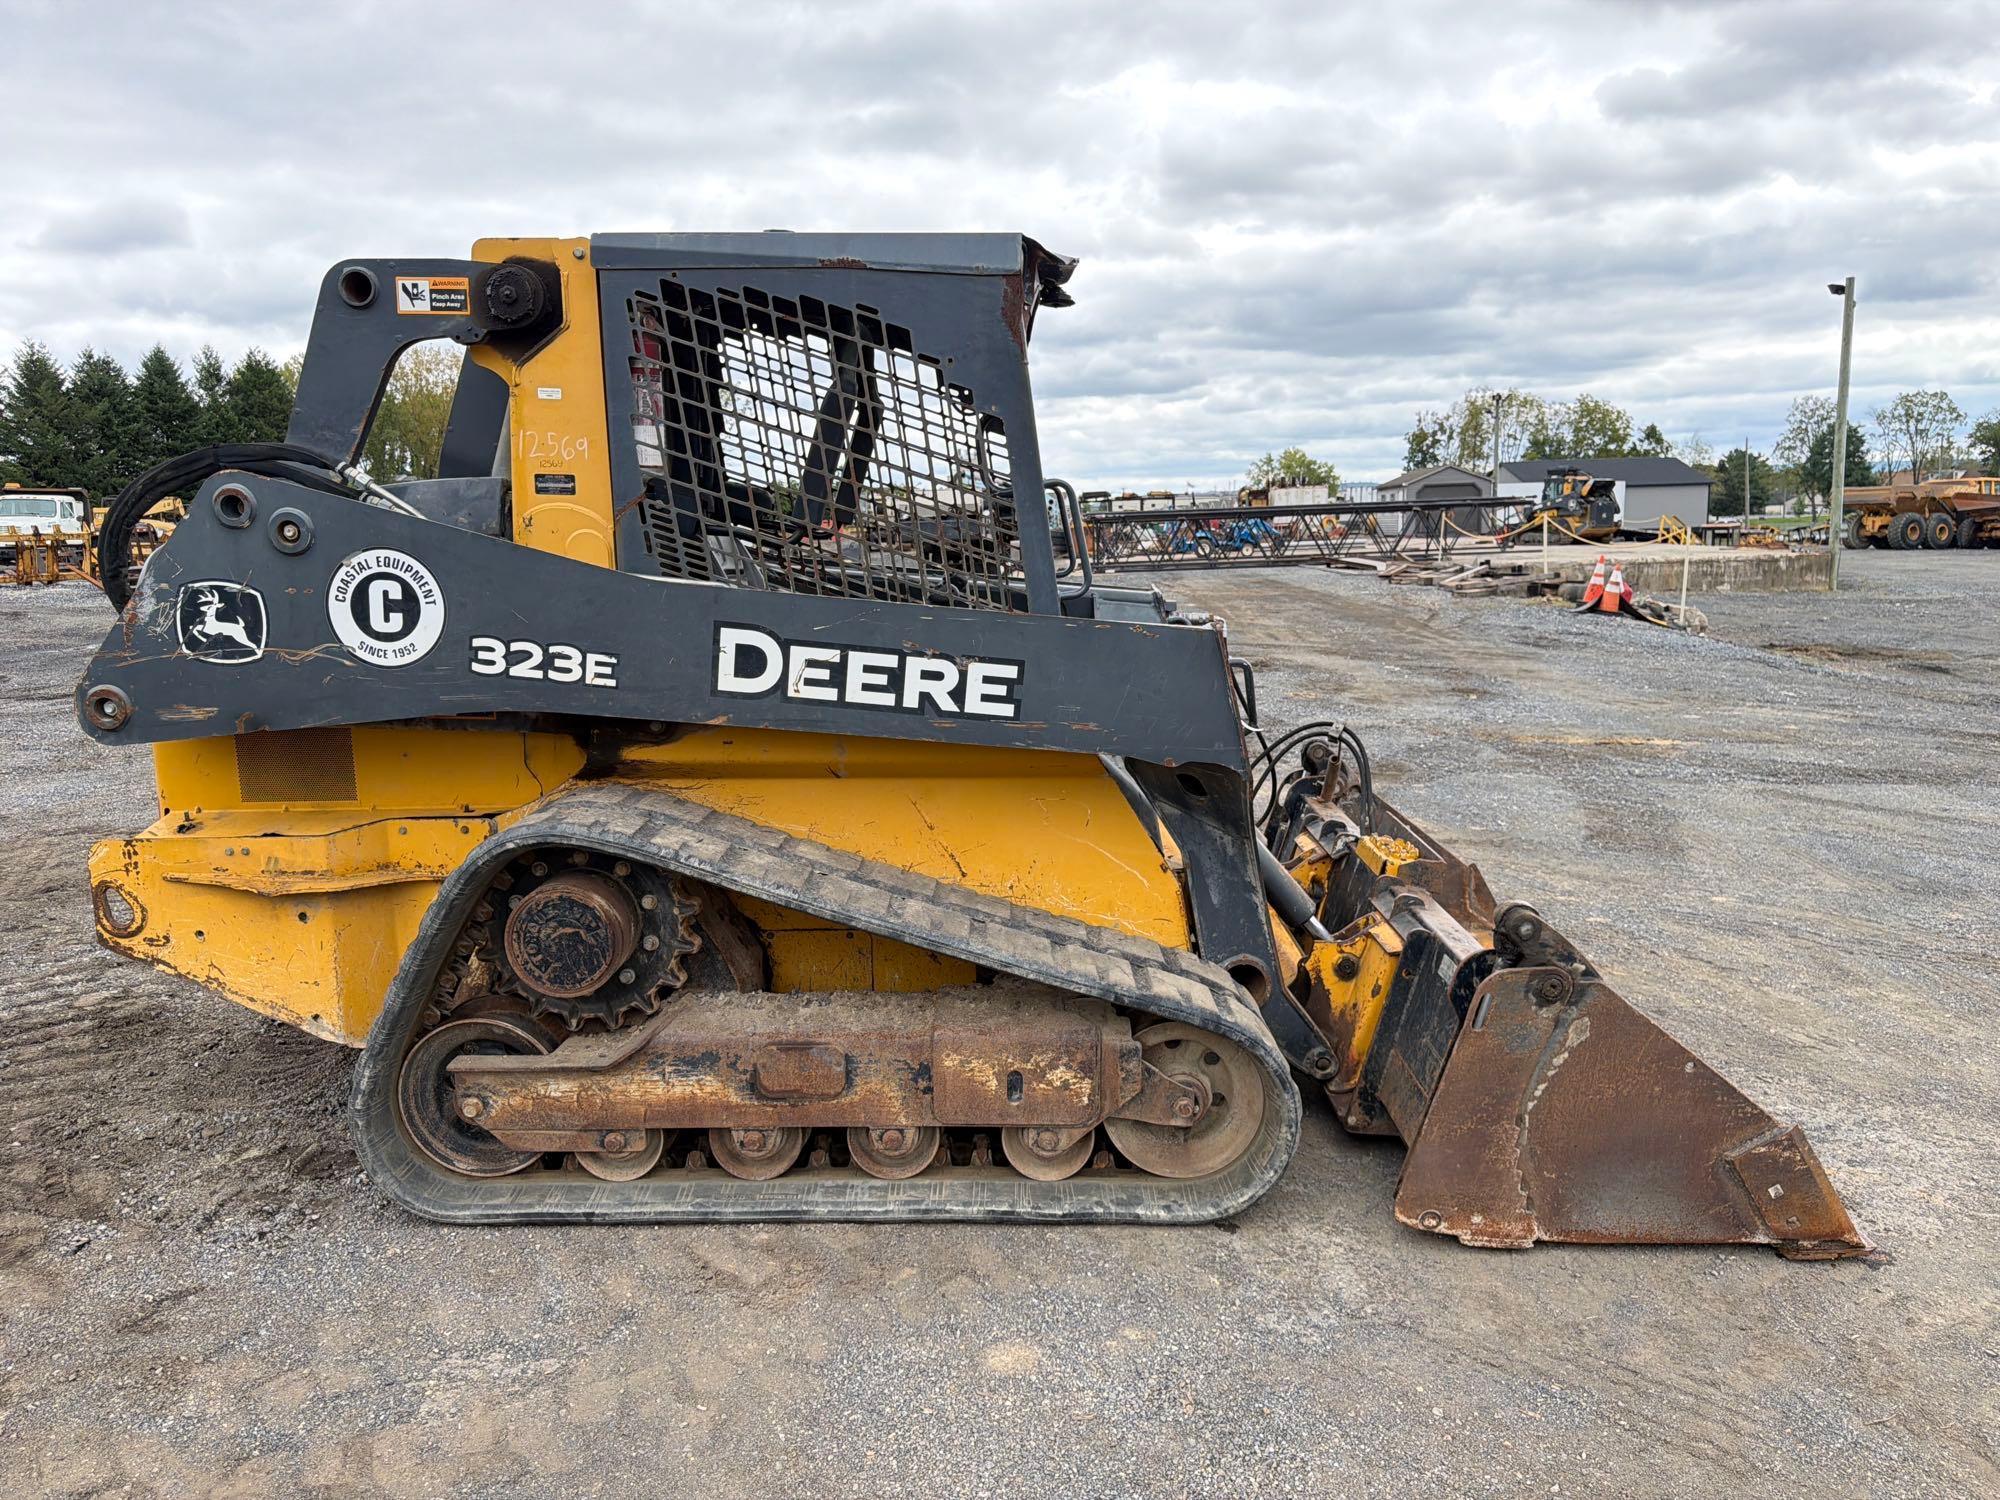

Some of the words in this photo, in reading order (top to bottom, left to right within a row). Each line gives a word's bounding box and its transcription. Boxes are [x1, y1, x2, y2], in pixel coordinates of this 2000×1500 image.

[518, 429, 589, 461] 12569
[334, 558, 373, 603] COASTAL
[375, 555, 437, 606] EQUIPMENT
[368, 579, 404, 633] C
[357, 640, 389, 659] SINCE
[391, 642, 418, 659] 1952
[471, 637, 618, 687] 323E
[717, 627, 1019, 718] DEERE
